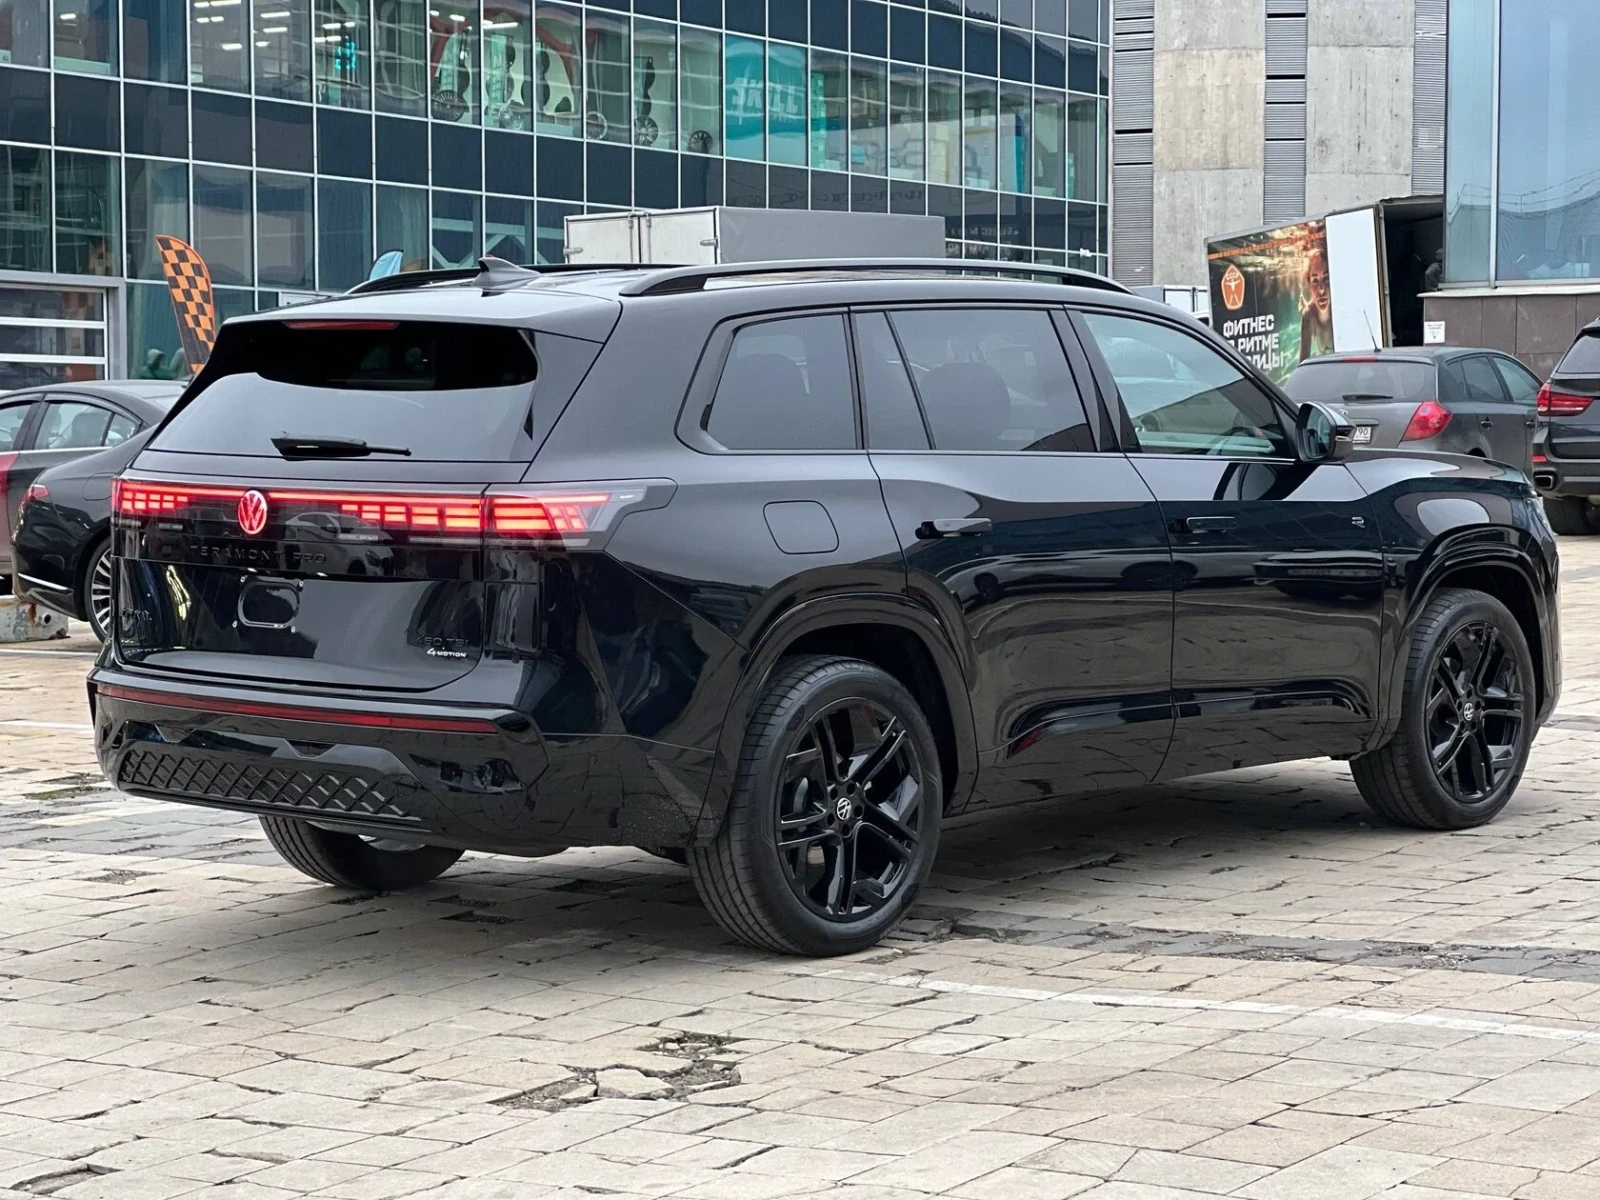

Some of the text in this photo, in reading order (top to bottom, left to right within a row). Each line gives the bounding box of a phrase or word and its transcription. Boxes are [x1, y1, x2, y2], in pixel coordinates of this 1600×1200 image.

[1223, 313, 1275, 338] ФИТНЕС
[1237, 332, 1280, 353] РИТМЕ
[189, 544, 327, 565] TERAMONT PRO
[426, 647, 467, 658] 4MOTION
